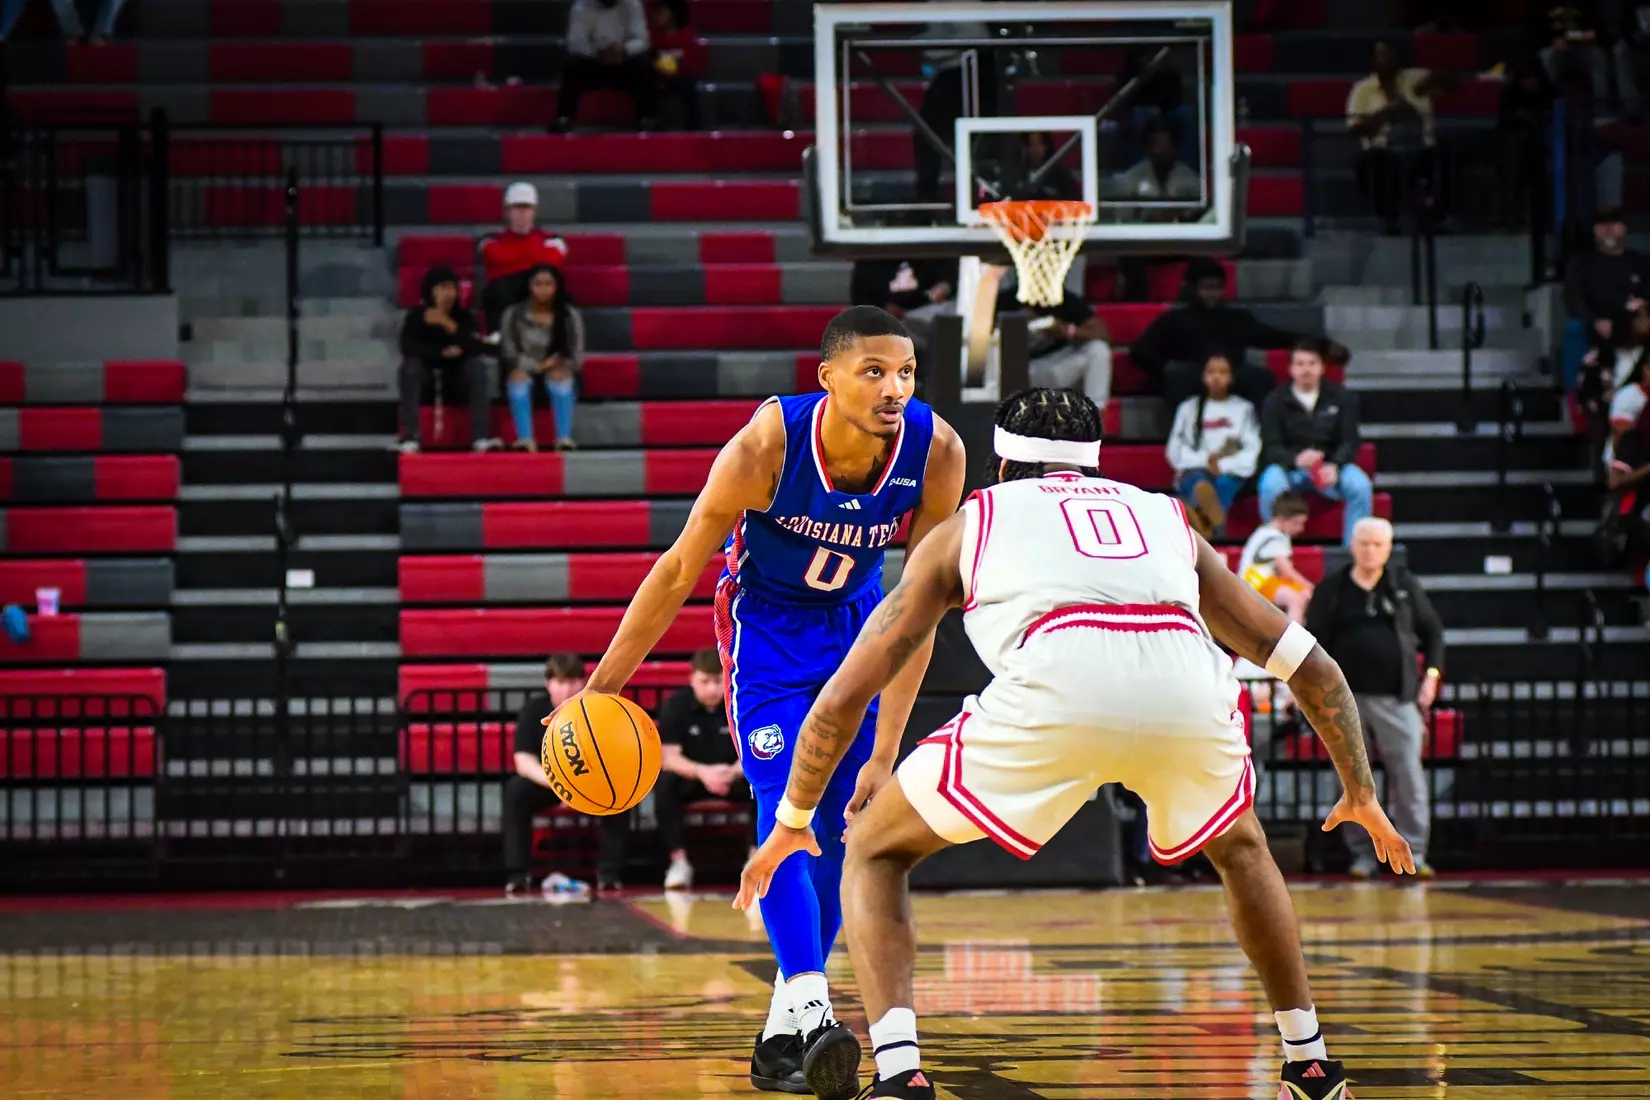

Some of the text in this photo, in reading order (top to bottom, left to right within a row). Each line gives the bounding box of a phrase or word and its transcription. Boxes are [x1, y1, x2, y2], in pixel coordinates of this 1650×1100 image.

[1038, 484, 1122, 496] BRYANT
[1059, 498, 1149, 560] 0
[803, 545, 857, 592] 0
[542, 735, 573, 803] Wilso
[560, 721, 590, 777] NCAA
